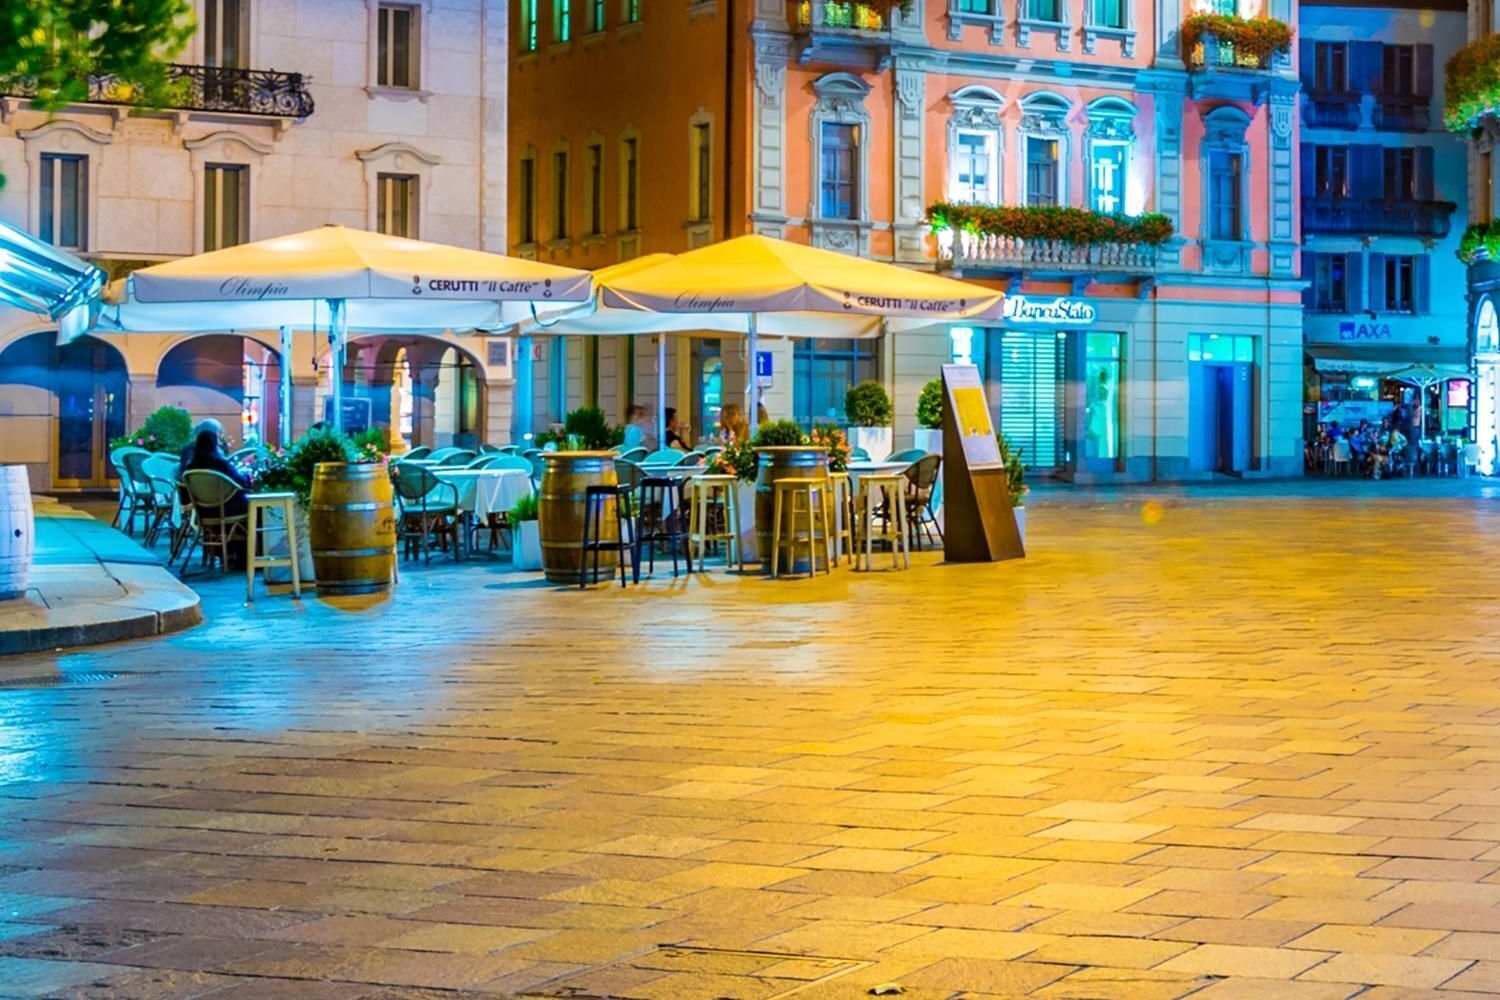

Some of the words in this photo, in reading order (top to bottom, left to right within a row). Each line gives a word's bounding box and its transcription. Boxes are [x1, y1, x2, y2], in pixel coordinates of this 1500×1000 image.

[218, 275, 289, 300] Olimpia
[429, 279, 478, 292] CERUTTI
[674, 289, 735, 312] Olimpia
[857, 296, 901, 309] CERUTTI
[1357, 323, 1391, 339] AXA
